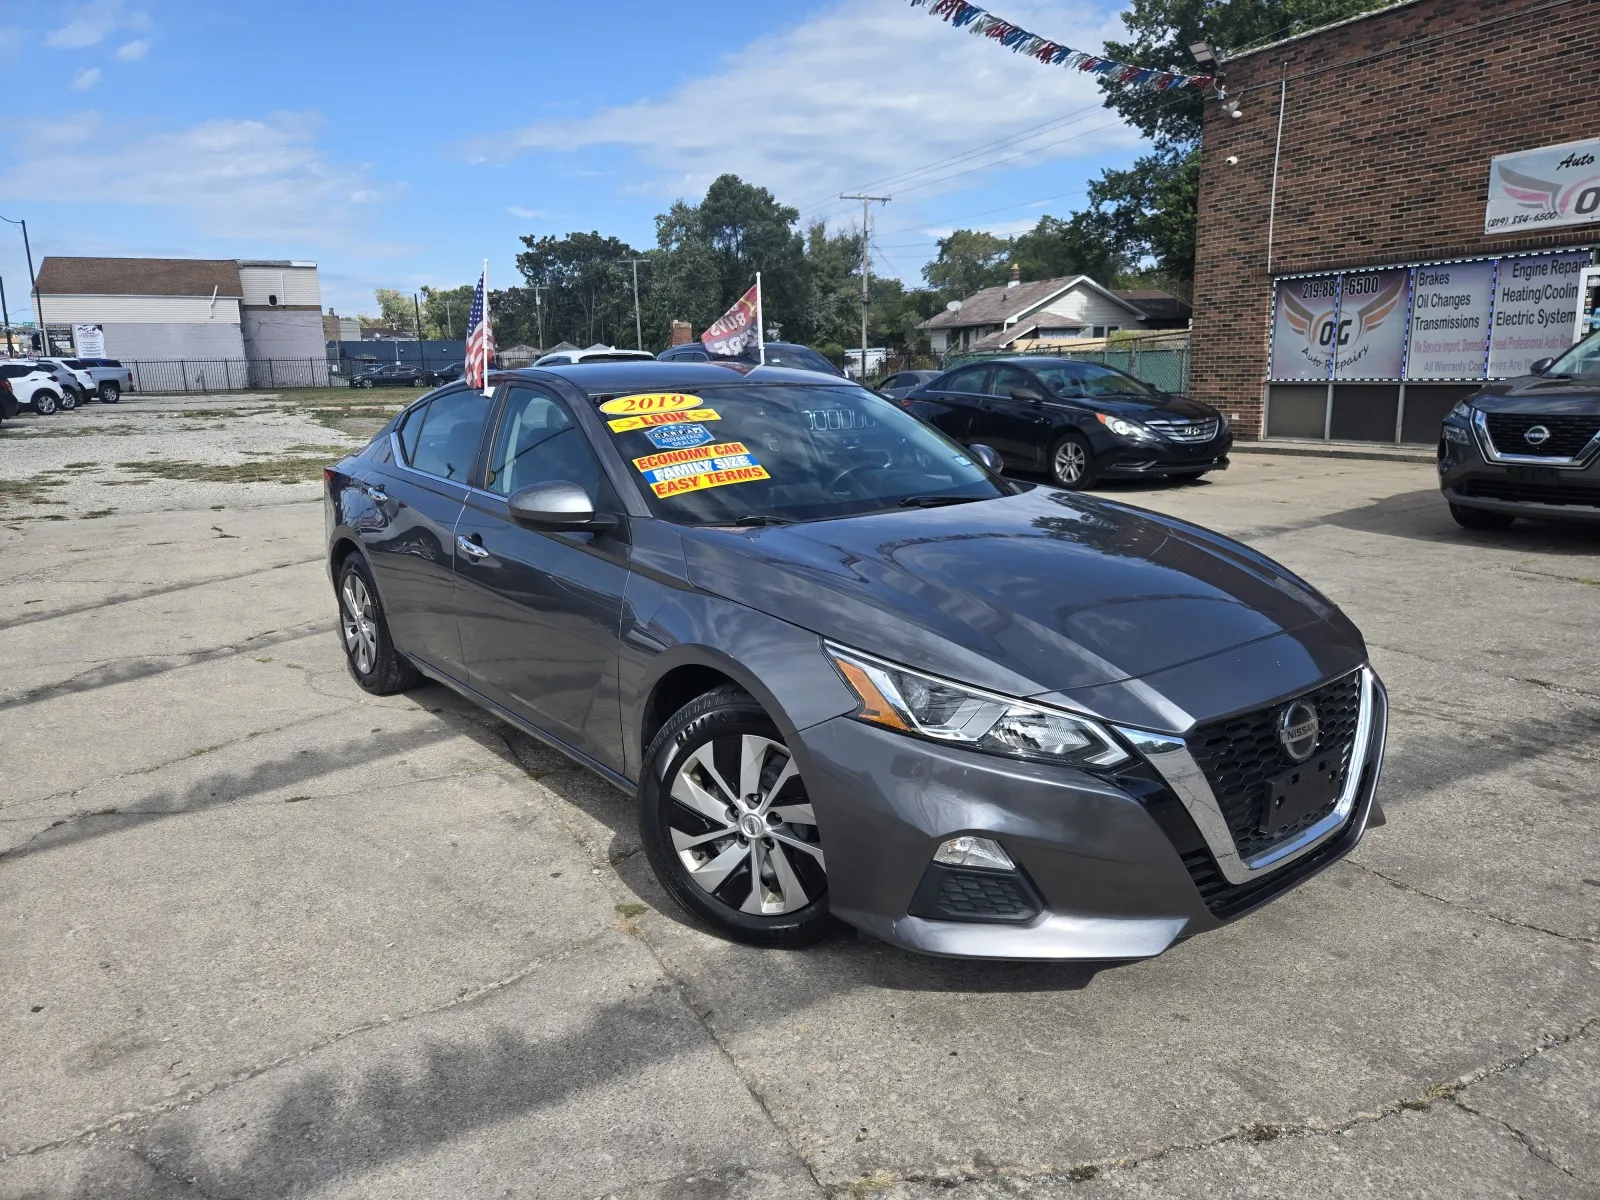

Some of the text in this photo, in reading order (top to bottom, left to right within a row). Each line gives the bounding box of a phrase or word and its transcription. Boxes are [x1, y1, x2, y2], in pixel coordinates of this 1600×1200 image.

[1556, 153, 1595, 171] Auto
[1487, 211, 1557, 228] (219) 884-6500
[1512, 258, 1587, 281] Engine Repair
[1418, 271, 1450, 287] Brakes
[1416, 293, 1471, 310] Oil Changes
[1502, 283, 1579, 304] Heating/Coolin
[1415, 315, 1480, 331] Transmissions
[1496, 310, 1535, 326] Electric
[1537, 308, 1577, 328] System
[1319, 319, 1353, 346] OG
[1423, 340, 1441, 353] Service
[1509, 334, 1543, 350] Professional
[1543, 334, 1559, 349] Auto
[1301, 347, 1323, 367] Auto
[1424, 360, 1434, 372] All
[1435, 360, 1467, 374] Warranty
[1468, 358, 1506, 372] Comnies
[1508, 359, 1521, 371] Are
[622, 394, 685, 412] 2019
[639, 411, 690, 426] LOOK
[661, 432, 705, 445] ADVANTAGE
[672, 438, 702, 448] DEALER
[636, 442, 744, 471] ECONOMY CAR
[652, 454, 753, 483] FAMILY SIZE
[655, 467, 764, 496] EASY TERMS
[1287, 722, 1316, 740] NISSAN
